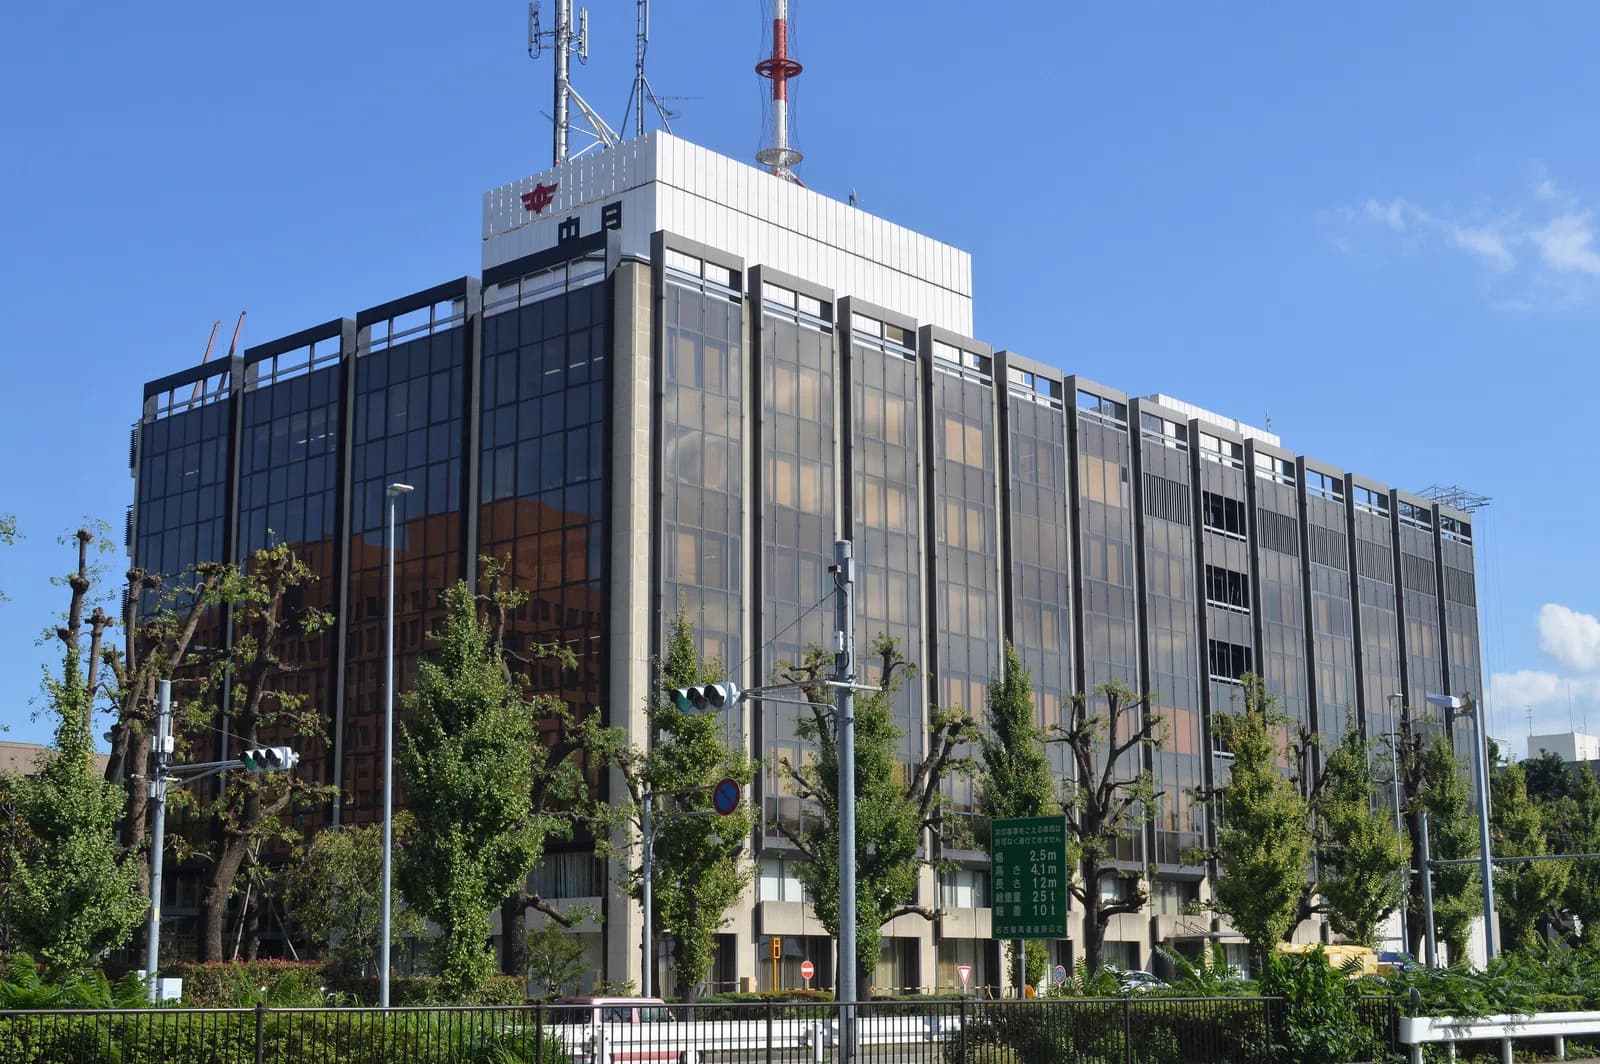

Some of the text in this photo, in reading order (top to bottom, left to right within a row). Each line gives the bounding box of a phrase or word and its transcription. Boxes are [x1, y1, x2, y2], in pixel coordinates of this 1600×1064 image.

[1030, 849, 1057, 862] 2.5m
[1030, 863, 1057, 876] 4.1m
[1032, 876, 1057, 889] 12m
